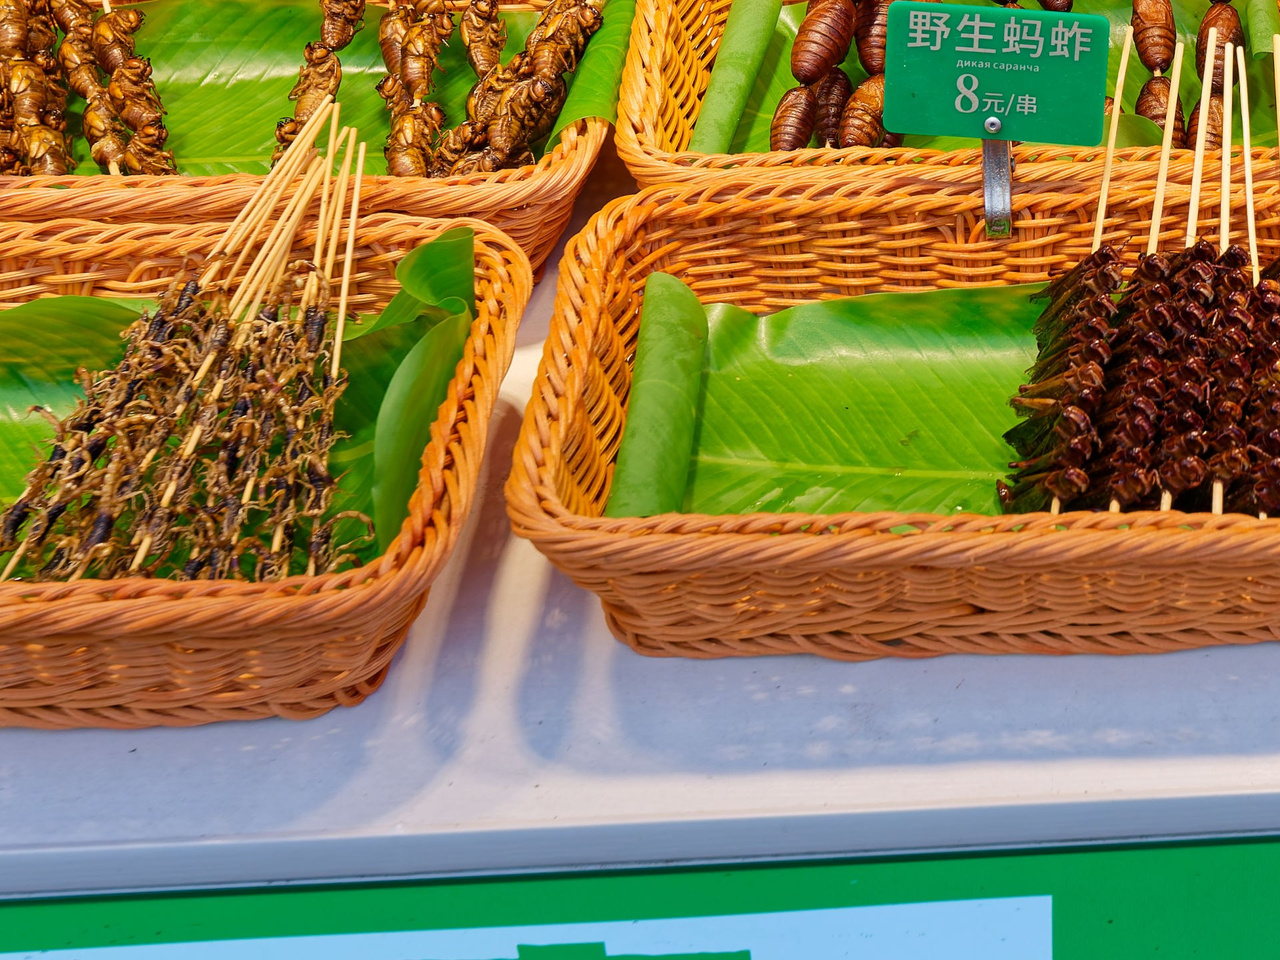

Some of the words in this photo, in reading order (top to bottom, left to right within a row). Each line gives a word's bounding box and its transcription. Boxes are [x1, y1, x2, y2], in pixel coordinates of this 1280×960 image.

[907, 10, 1093, 61] 野生蚂蚱
[956, 58, 990, 69] дикая
[993, 61, 1040, 72] саранча
